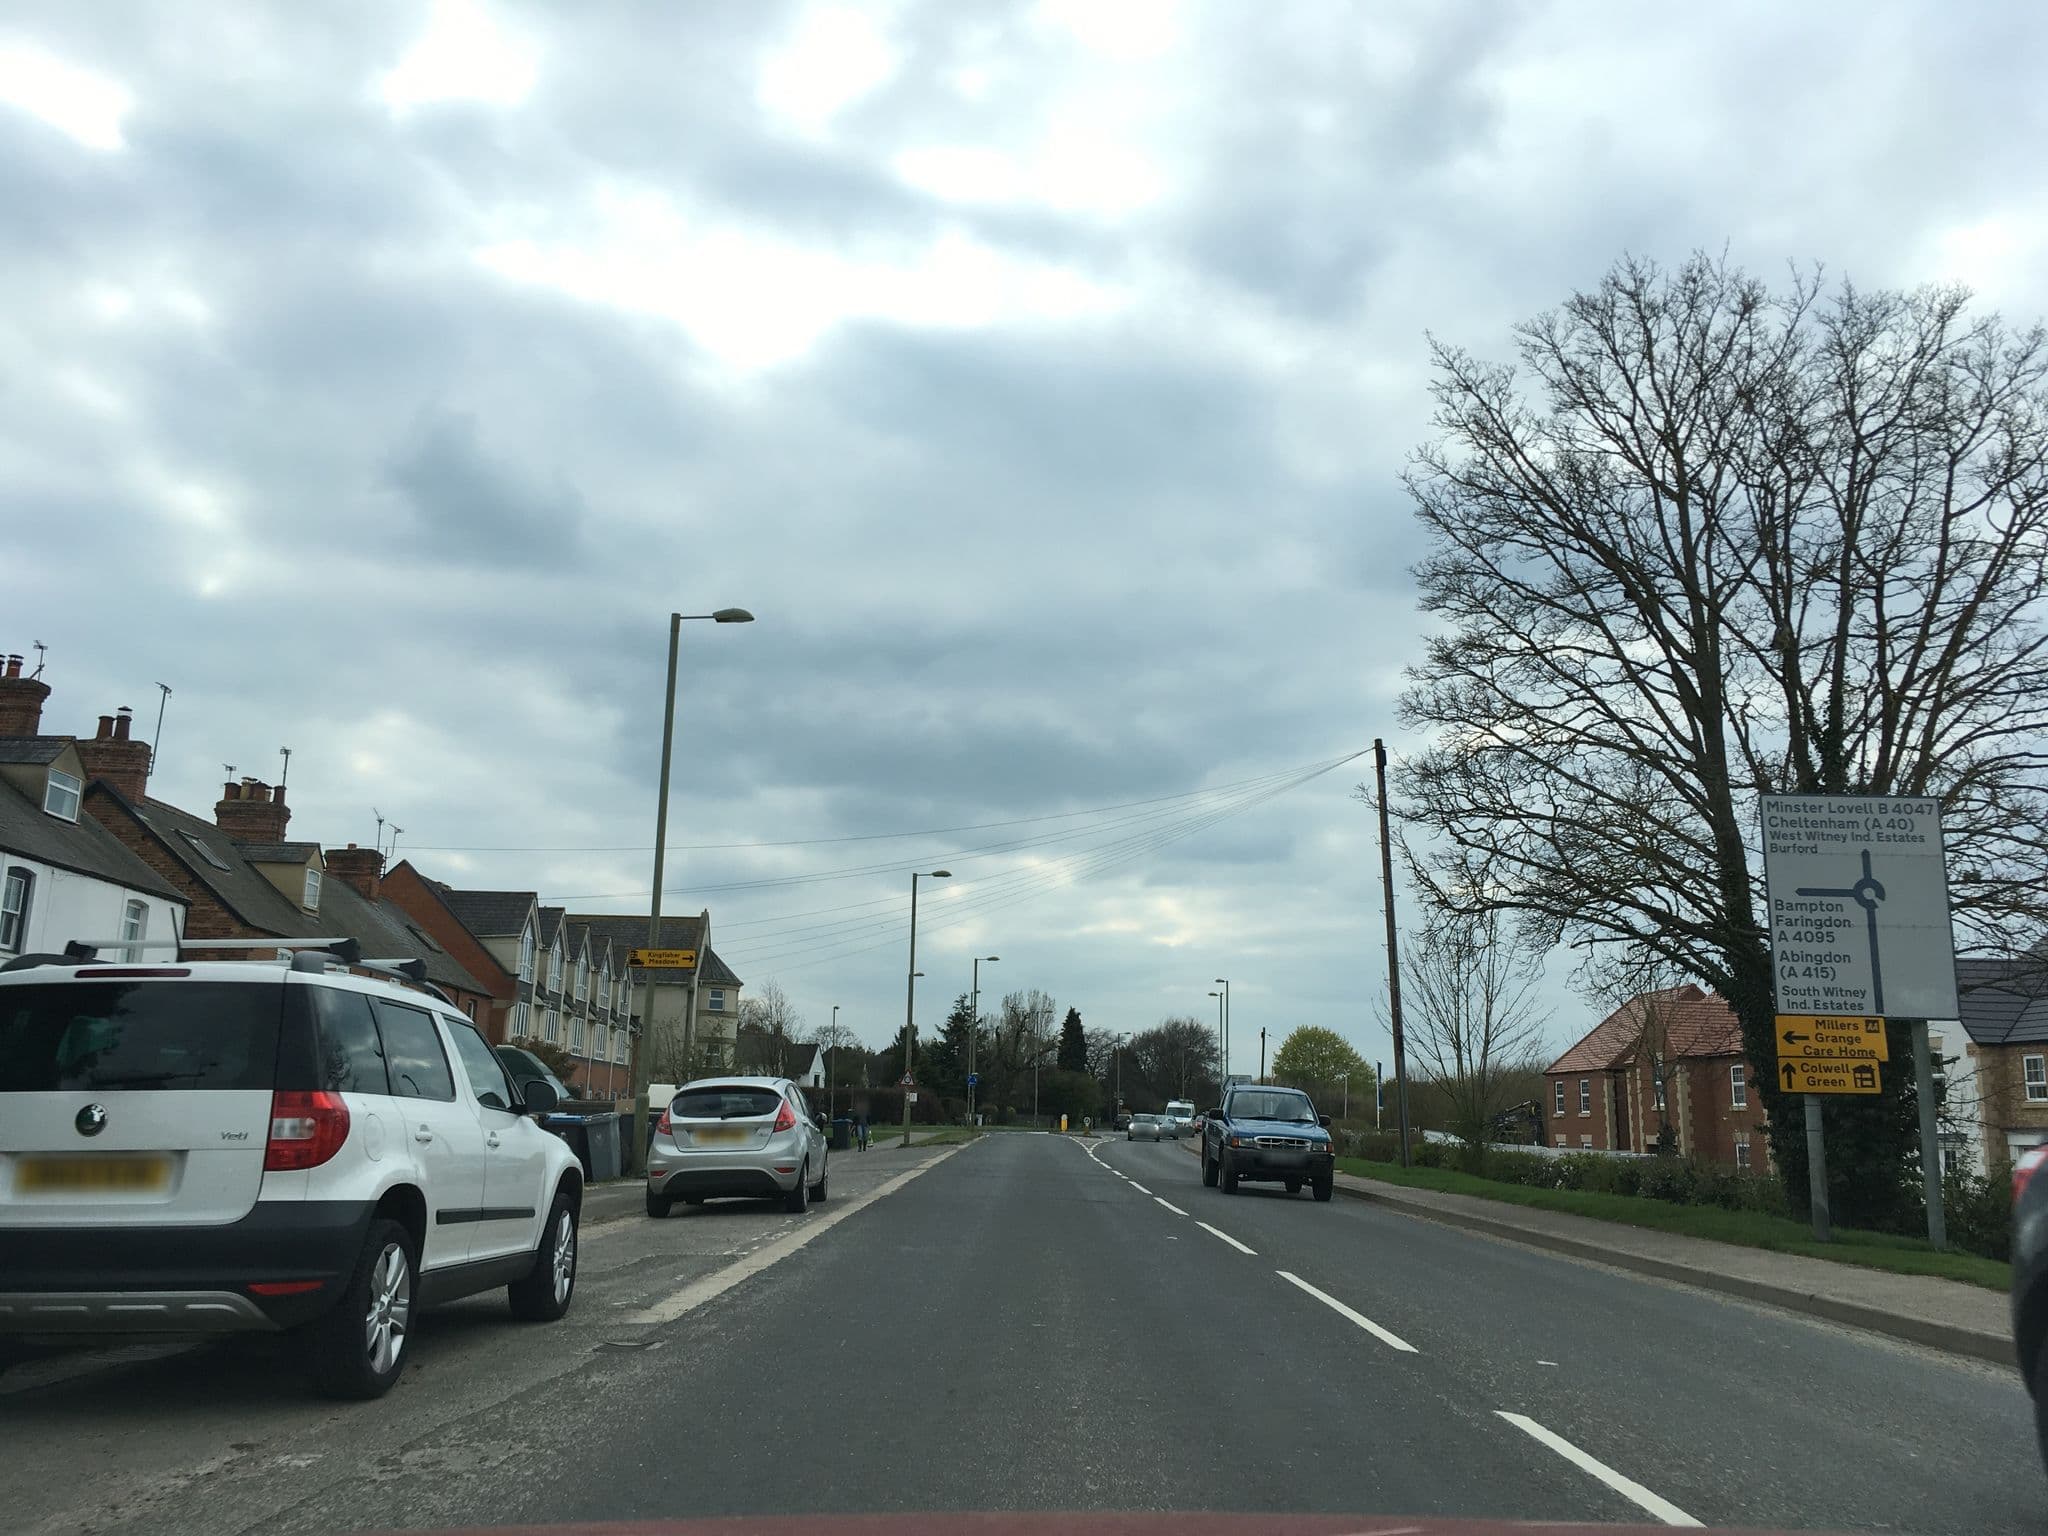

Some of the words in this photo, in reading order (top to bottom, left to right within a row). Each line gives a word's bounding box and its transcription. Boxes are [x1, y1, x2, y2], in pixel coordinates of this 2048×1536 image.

[1766, 801, 1824, 814] Minster
[1828, 802, 1873, 815] Lovell
[1878, 803, 1888, 815] B
[1892, 803, 1934, 816] 4047
[1768, 815, 1860, 830] Cheltenham
[1864, 817, 1882, 832] (A
[1886, 818, 1915, 832] 40)
[1769, 830, 1802, 841] West
[1806, 831, 1848, 843] Witney
[1851, 832, 1874, 843] Ind.
[1877, 832, 1926, 843] Estates
[1770, 843, 1818, 854] Burford
[1774, 899, 1844, 914] Bampton
[1775, 915, 1852, 930] Faringdon
[1777, 930, 1789, 943] A
[1792, 930, 1836, 943] 4095
[1779, 950, 1852, 966] Abingdon
[1780, 965, 1798, 980] (A
[1802, 966, 1836, 982] 415)
[1782, 985, 1820, 997] South
[1823, 986, 1867, 999] Witney
[1786, 999, 1811, 1010] Ind.
[1813, 999, 1865, 1011] Estates
[1815, 1019, 1859, 1031] Millers
[1814, 1032, 1862, 1046] Grange
[1803, 1045, 1834, 1056] Care
[1838, 1047, 1876, 1058] Home
[1800, 1062, 1850, 1074] Colwell
[1806, 1076, 1847, 1087] Green
